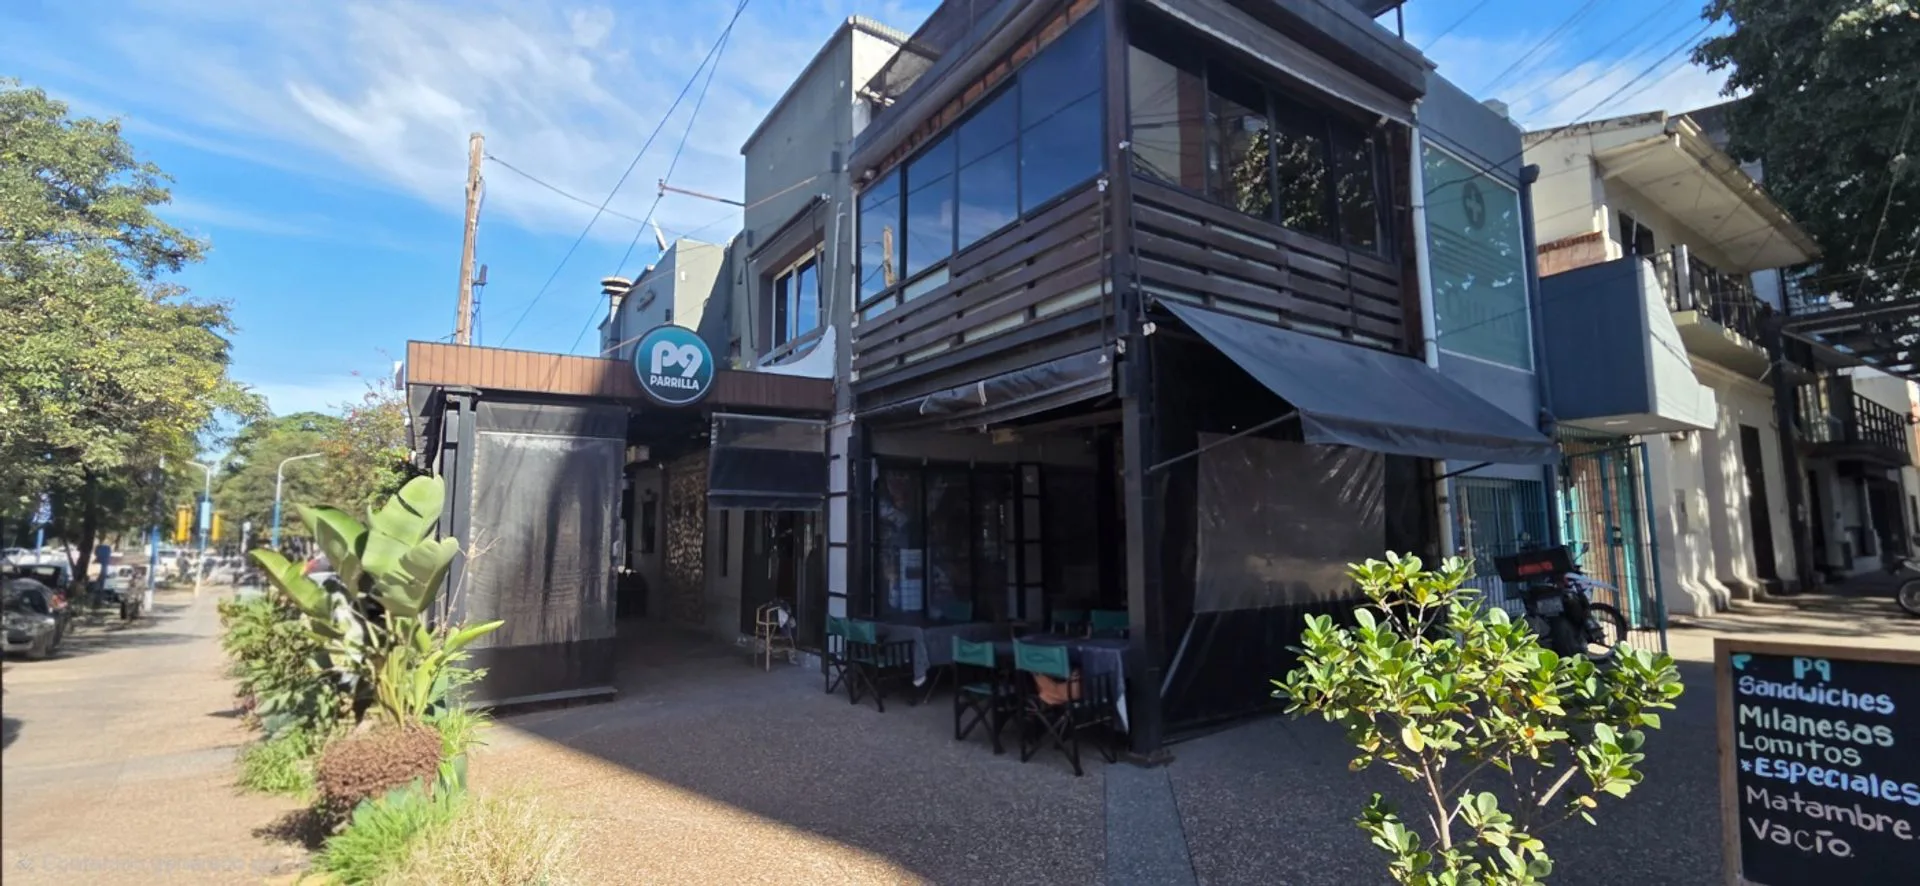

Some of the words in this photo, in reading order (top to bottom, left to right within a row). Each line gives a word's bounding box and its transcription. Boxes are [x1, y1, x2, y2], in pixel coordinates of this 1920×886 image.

[651, 340, 703, 378] P9
[650, 375, 699, 390] PARRILLA
[1738, 675, 1895, 715] Sandwiches
[1739, 704, 1894, 747] Milanesas
[1738, 732, 1862, 767] Lomitos
